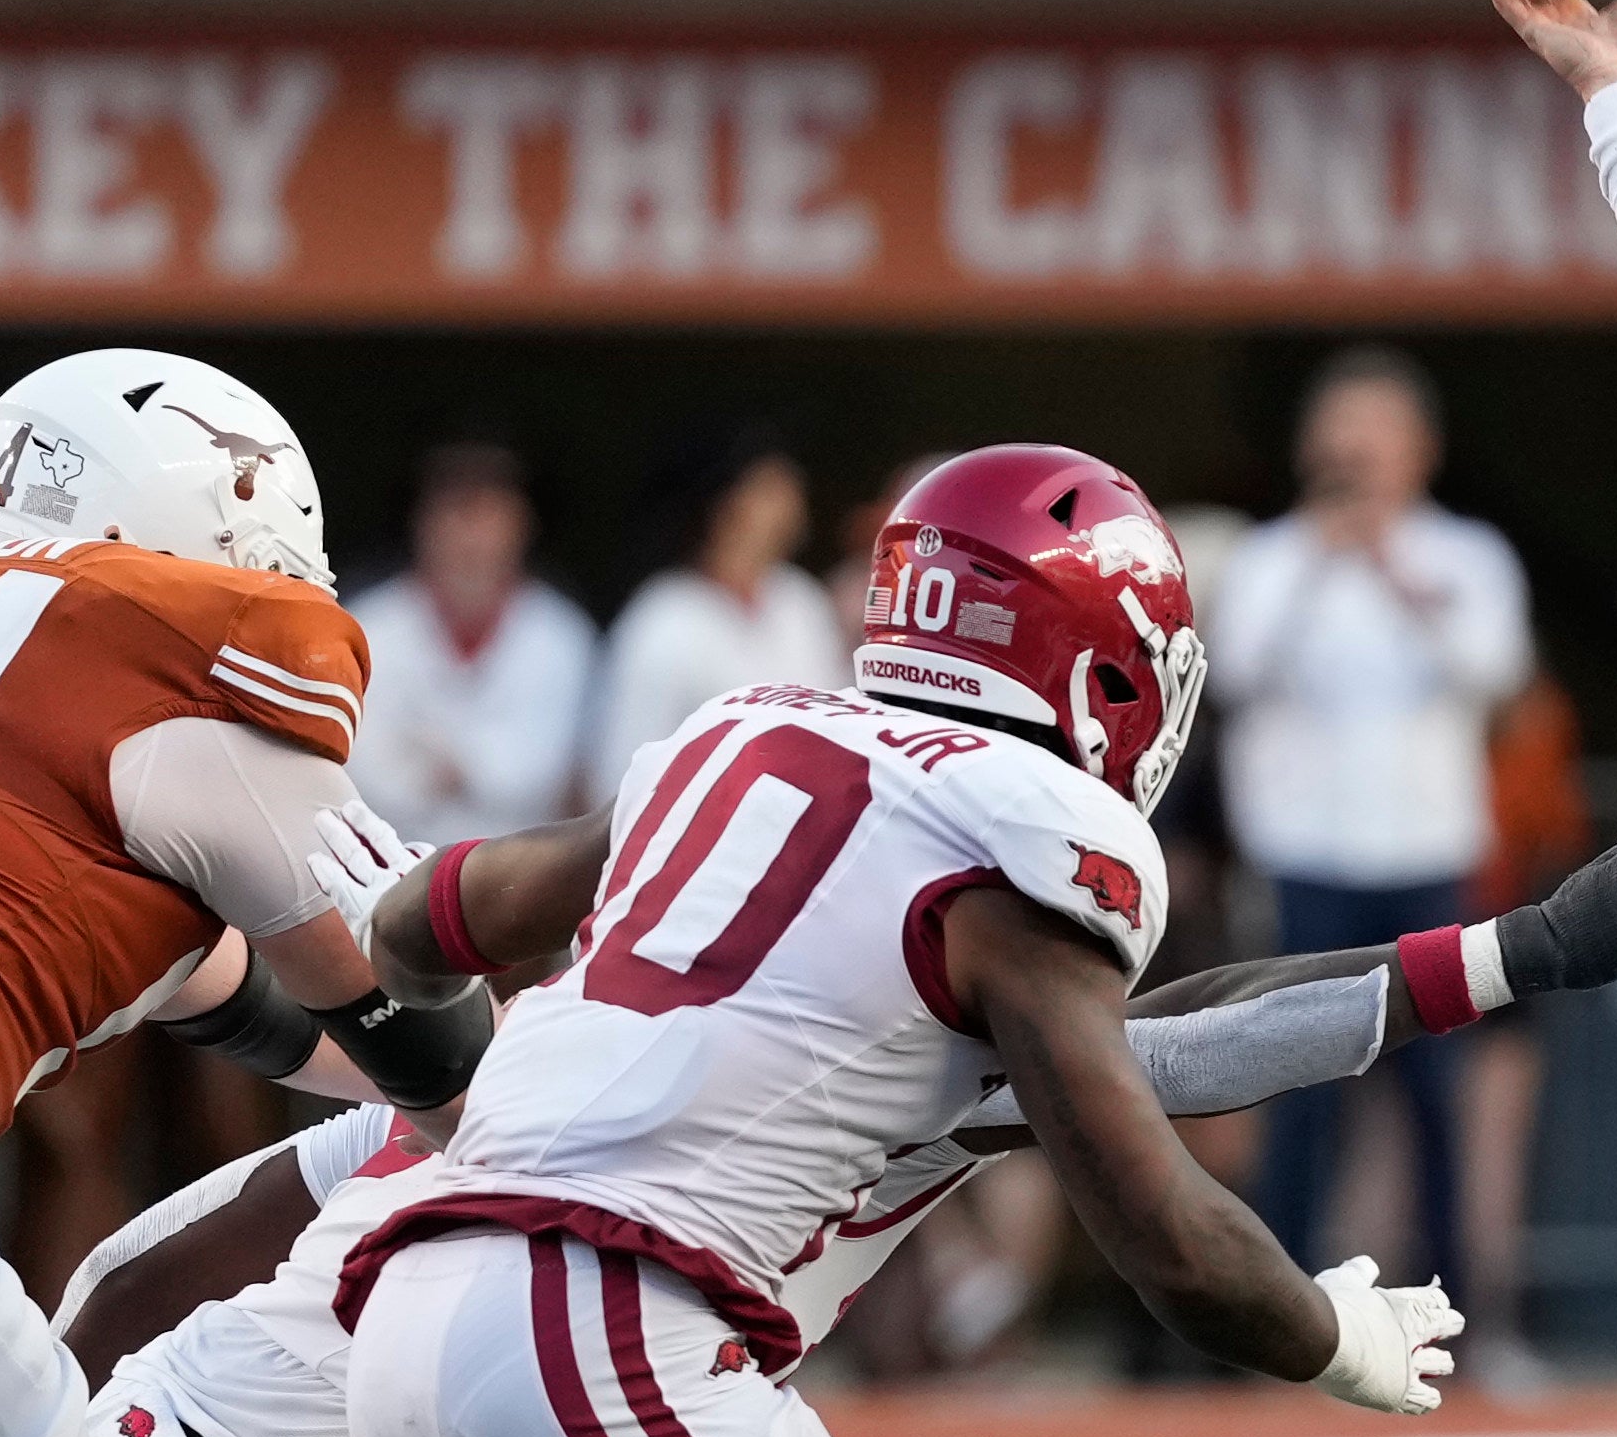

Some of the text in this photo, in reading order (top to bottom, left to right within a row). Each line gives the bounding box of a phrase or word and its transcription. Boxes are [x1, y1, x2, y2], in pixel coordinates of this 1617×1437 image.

[398, 56, 876, 282] THE
[890, 562, 957, 633] 10
[876, 727, 991, 774] JR
[540, 717, 873, 1018] 10
